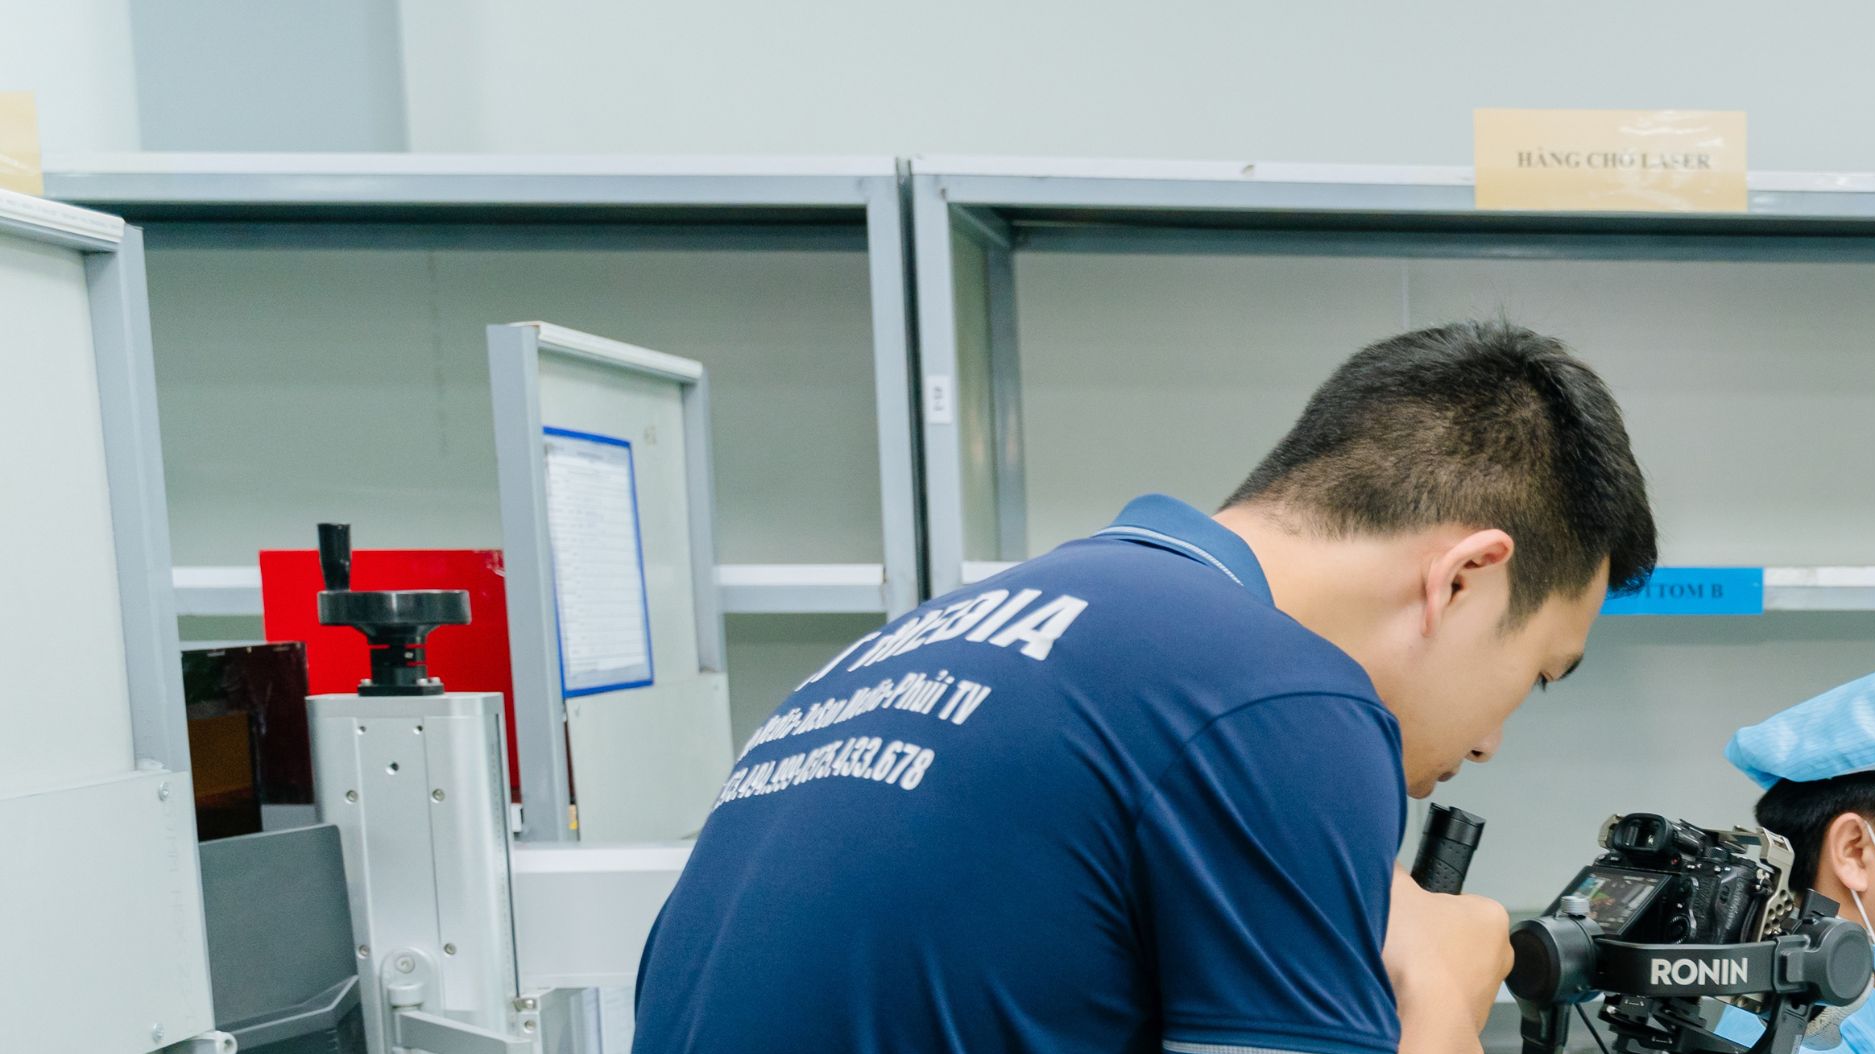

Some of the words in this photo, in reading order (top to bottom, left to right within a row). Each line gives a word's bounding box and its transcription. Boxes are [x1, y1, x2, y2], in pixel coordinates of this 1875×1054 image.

[1516, 147, 1580, 169] HÀNG
[1641, 152, 1712, 170] LASER
[1711, 583, 1724, 599] B
[847, 588, 1088, 661] MEDIA
[938, 680, 992, 725] TV
[1650, 957, 1748, 985] RONIN
